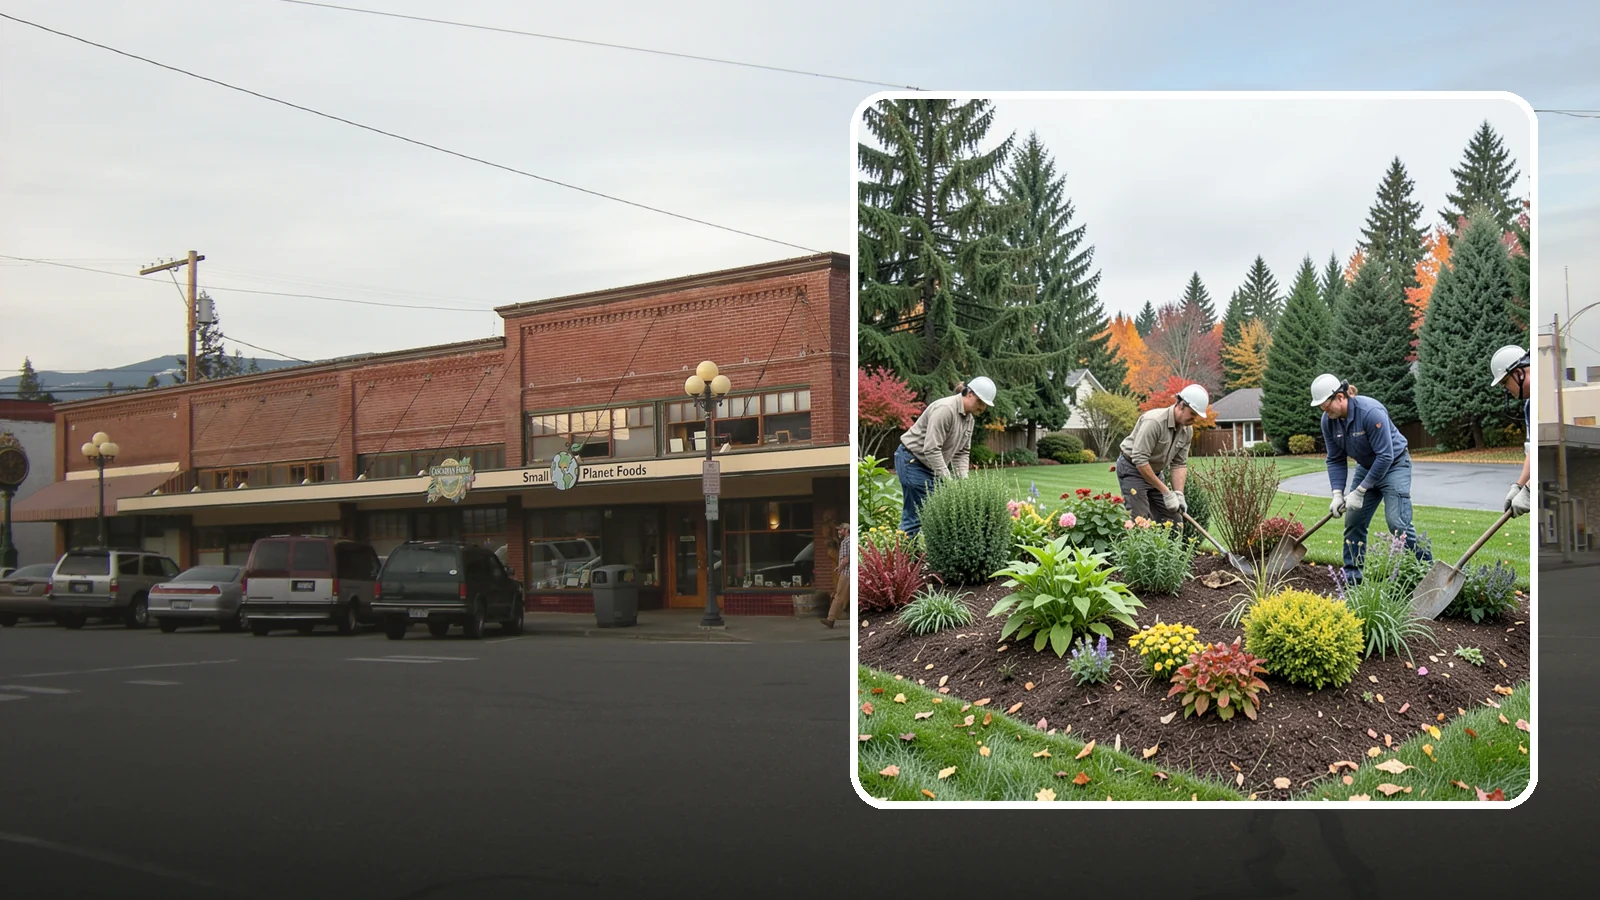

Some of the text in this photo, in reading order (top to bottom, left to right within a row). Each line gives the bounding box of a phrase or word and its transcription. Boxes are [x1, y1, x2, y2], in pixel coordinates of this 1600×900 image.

[432, 466, 469, 476] CASCADIAN FARM
[522, 464, 646, 482] Small Planet Foods
